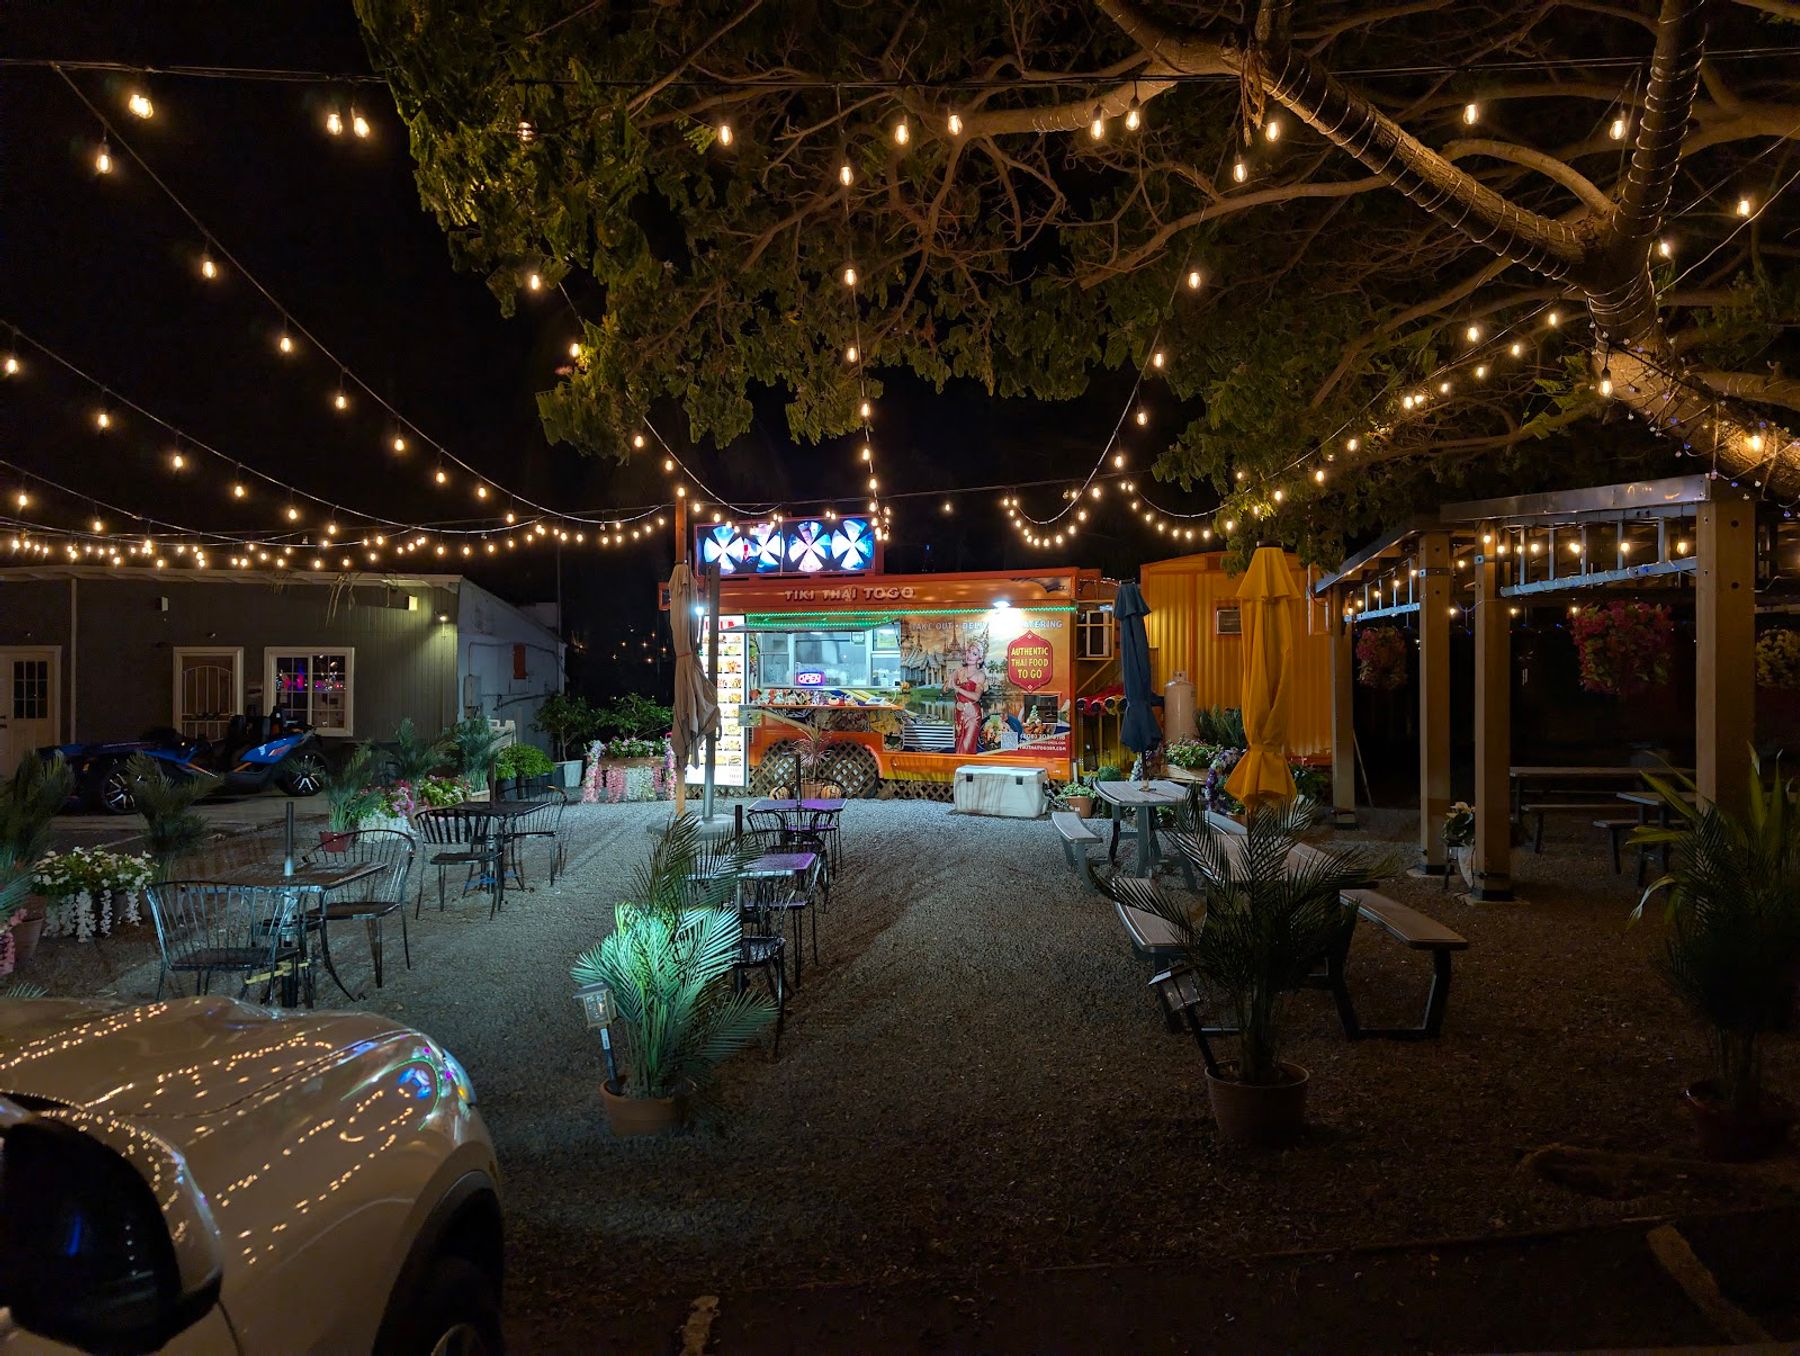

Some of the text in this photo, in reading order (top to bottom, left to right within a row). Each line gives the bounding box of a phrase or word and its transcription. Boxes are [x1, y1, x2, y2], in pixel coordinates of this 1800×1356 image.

[784, 590, 815, 600] TIKI
[822, 587, 857, 601] THAI
[910, 622, 932, 631] TAKE
[935, 622, 953, 630] OUT
[1011, 647, 1049, 656] AUTHENTIC
[1011, 658, 1049, 667] THAI FOOD
[798, 673, 821, 684] OPEN
[1018, 669, 1042, 679] TO GO
